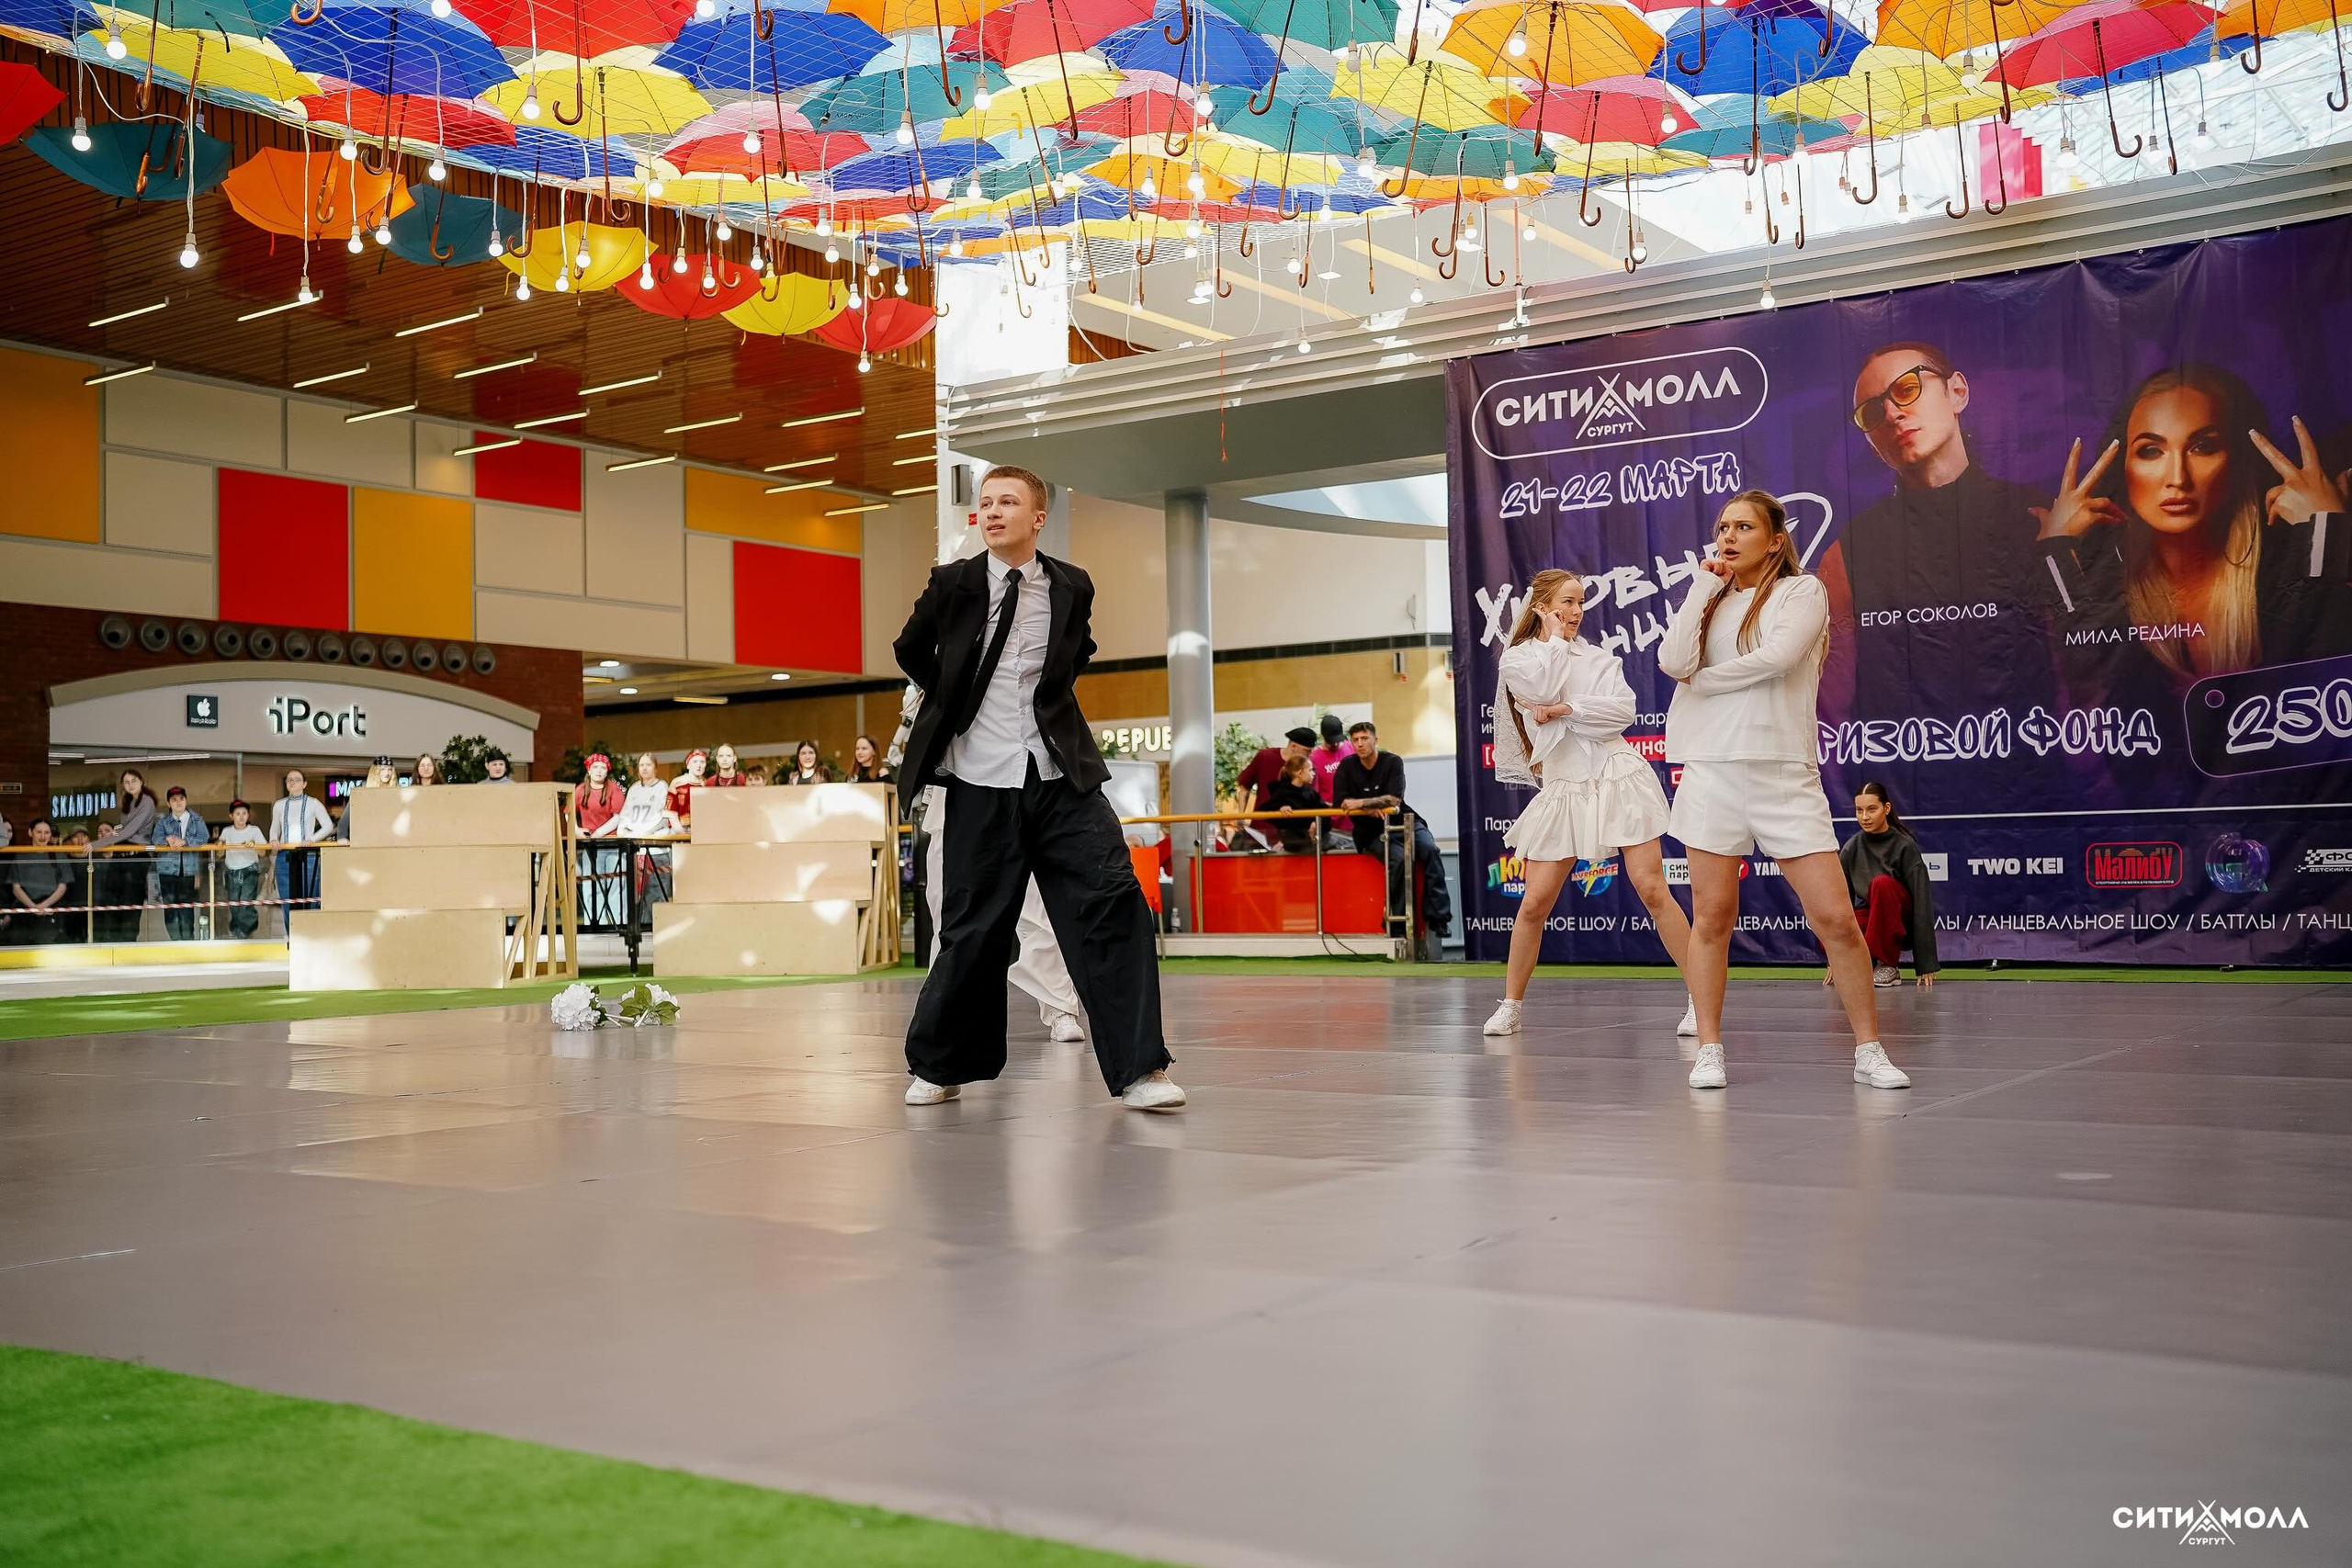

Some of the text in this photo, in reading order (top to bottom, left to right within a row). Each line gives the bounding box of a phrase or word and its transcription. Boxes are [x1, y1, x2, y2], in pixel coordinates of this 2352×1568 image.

[1587, 421, 1634, 437] СУРГУТ
[1499, 452, 1742, 519] 21-22 МАРТА
[1861, 603, 1998, 626] ЕГОР СОКОЛОВ
[2065, 622, 2206, 646] МИЛА РЕДИНА
[266, 695, 367, 738] iPort
[1816, 705, 2161, 764] РИЗОВОЙ ФОНД
[1967, 857, 2064, 875] TWO KEI
[1579, 916, 1617, 931] ШОУ
[1978, 914, 2125, 931] ТАНЦЕВАЛЬНОЕ
[2131, 913, 2179, 930] ШОУ
[2200, 913, 2276, 930] БАТТЛЫ
